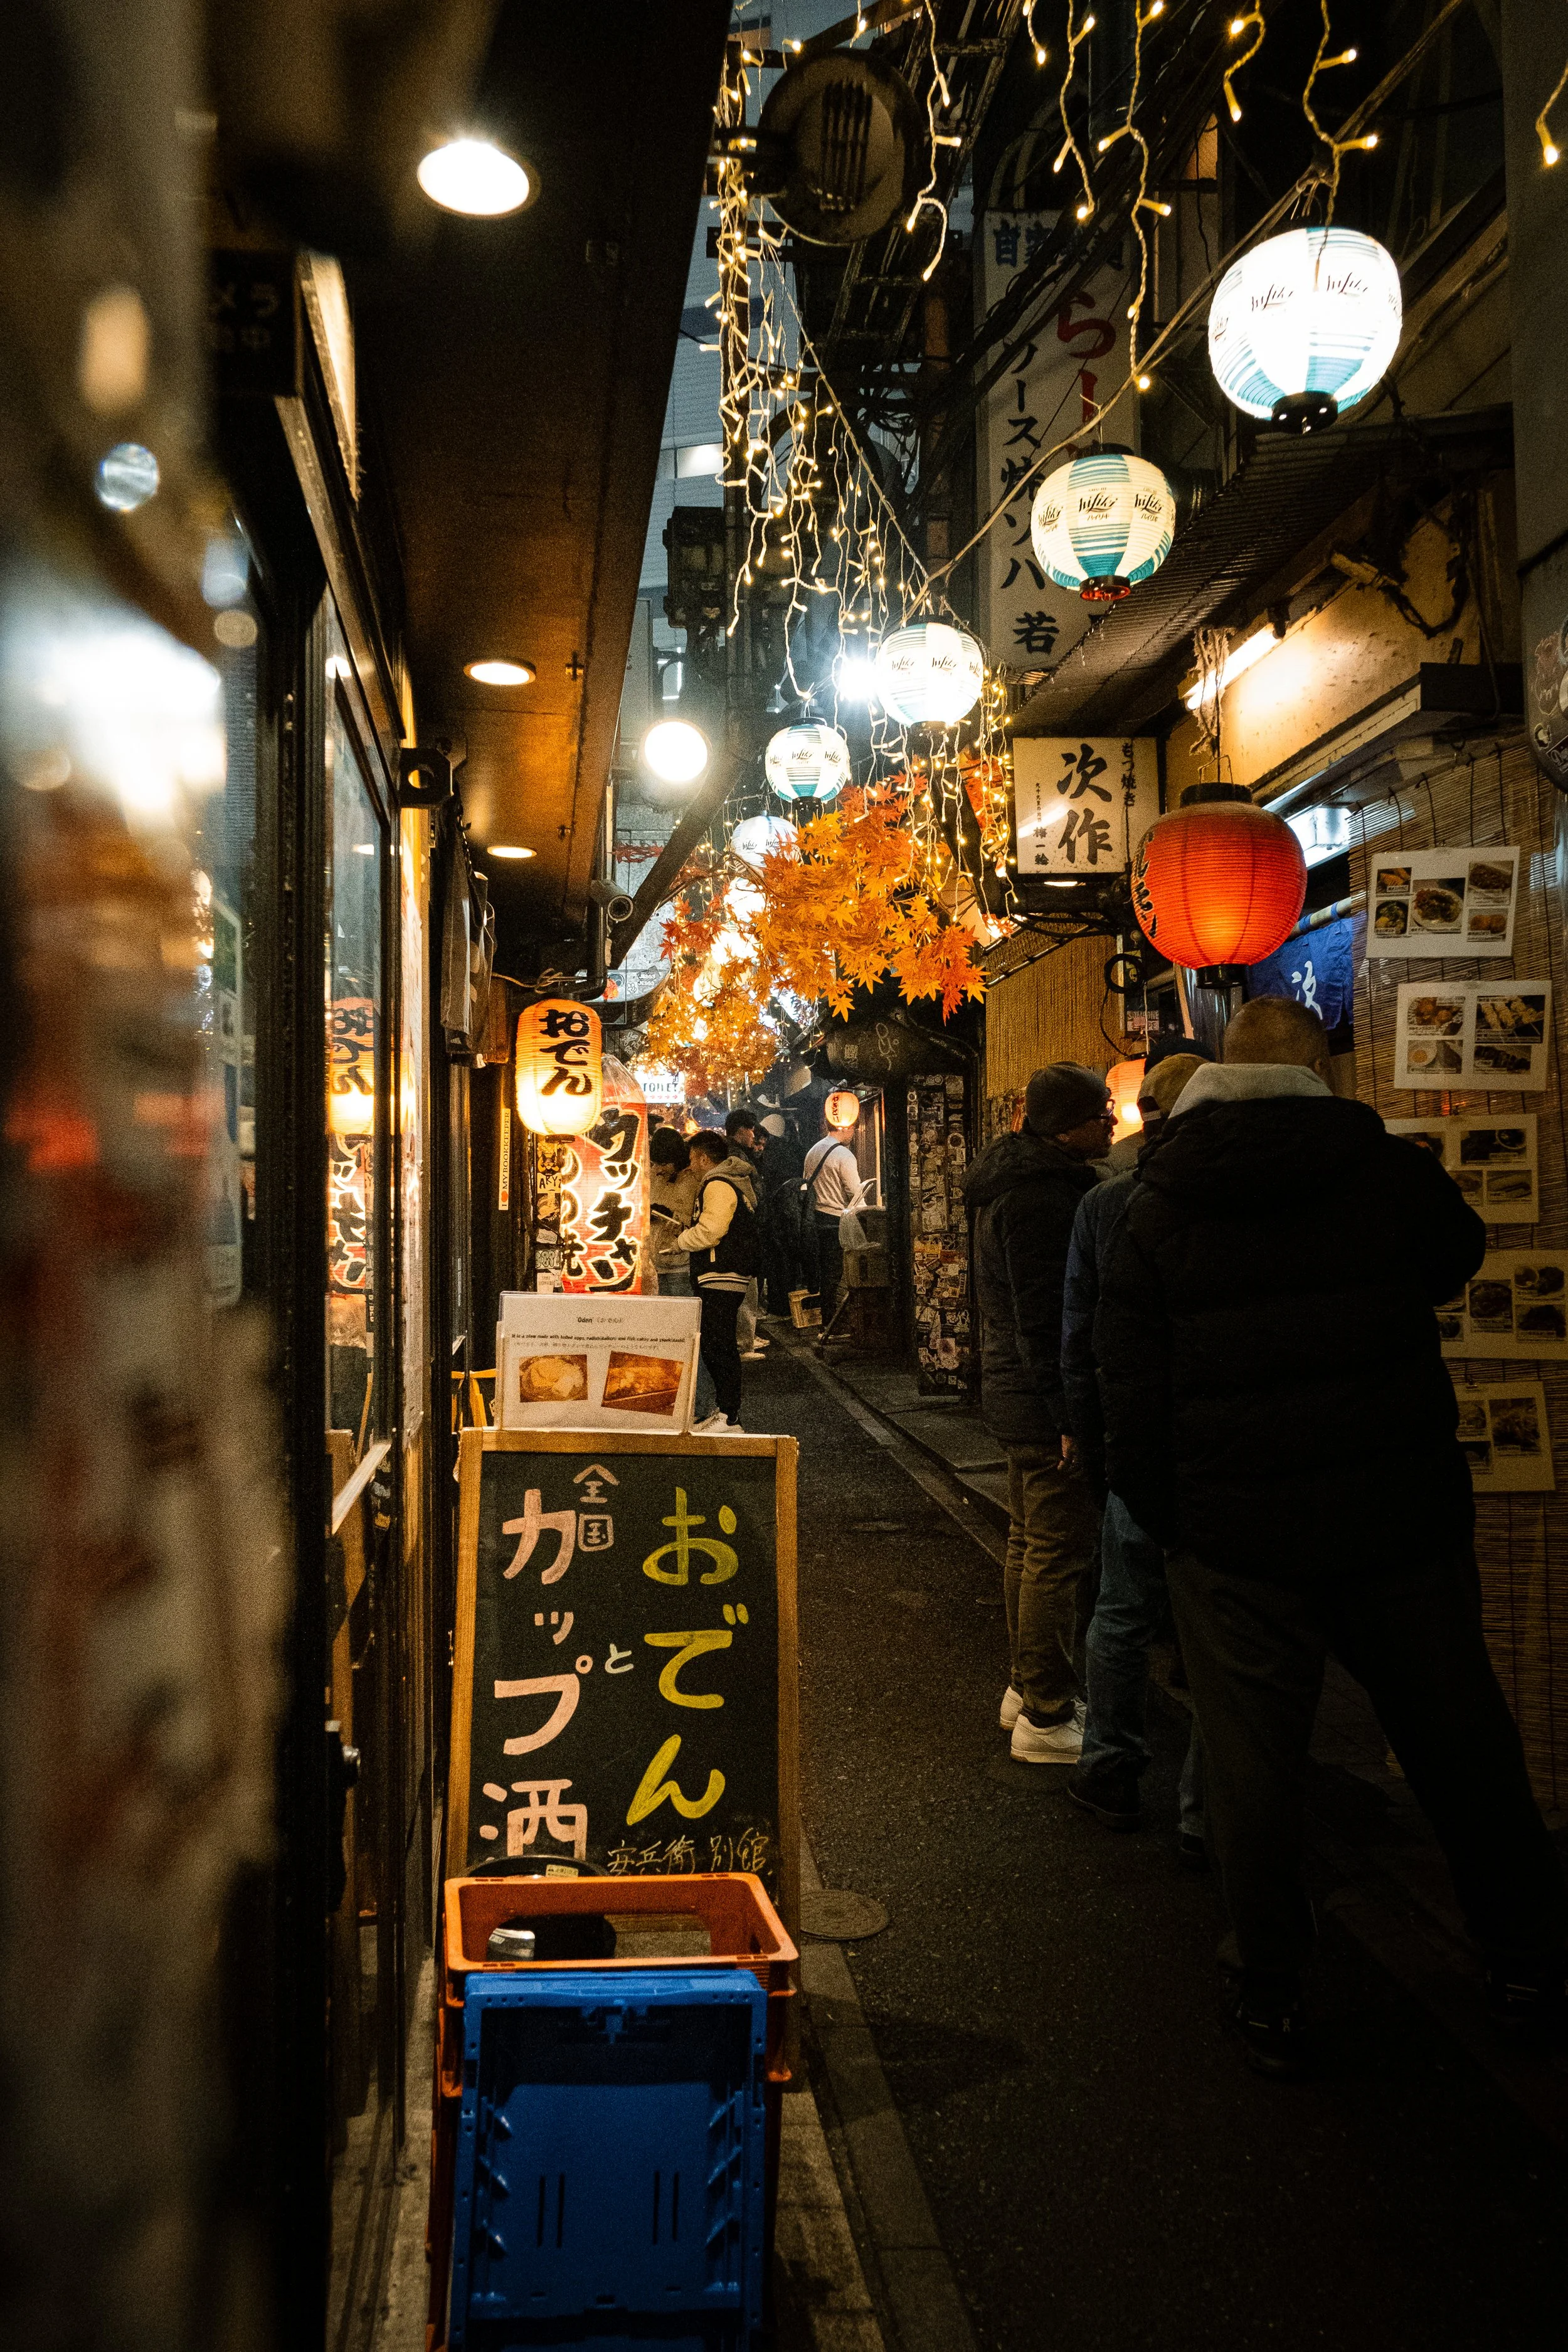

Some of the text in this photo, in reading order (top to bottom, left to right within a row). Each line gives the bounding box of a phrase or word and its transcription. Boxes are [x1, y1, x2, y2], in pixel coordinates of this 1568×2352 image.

[1057, 743, 1113, 865] 次作
[1121, 743, 1137, 807] もつ焼き
[539, 1009, 592, 1097] おでん
[573, 1464, 620, 1552] 全国
[479, 1489, 593, 1861] カップ酒
[605, 1643, 633, 1674] と
[627, 1486, 749, 1826] おでん
[607, 1834, 696, 1875] 安兵衛
